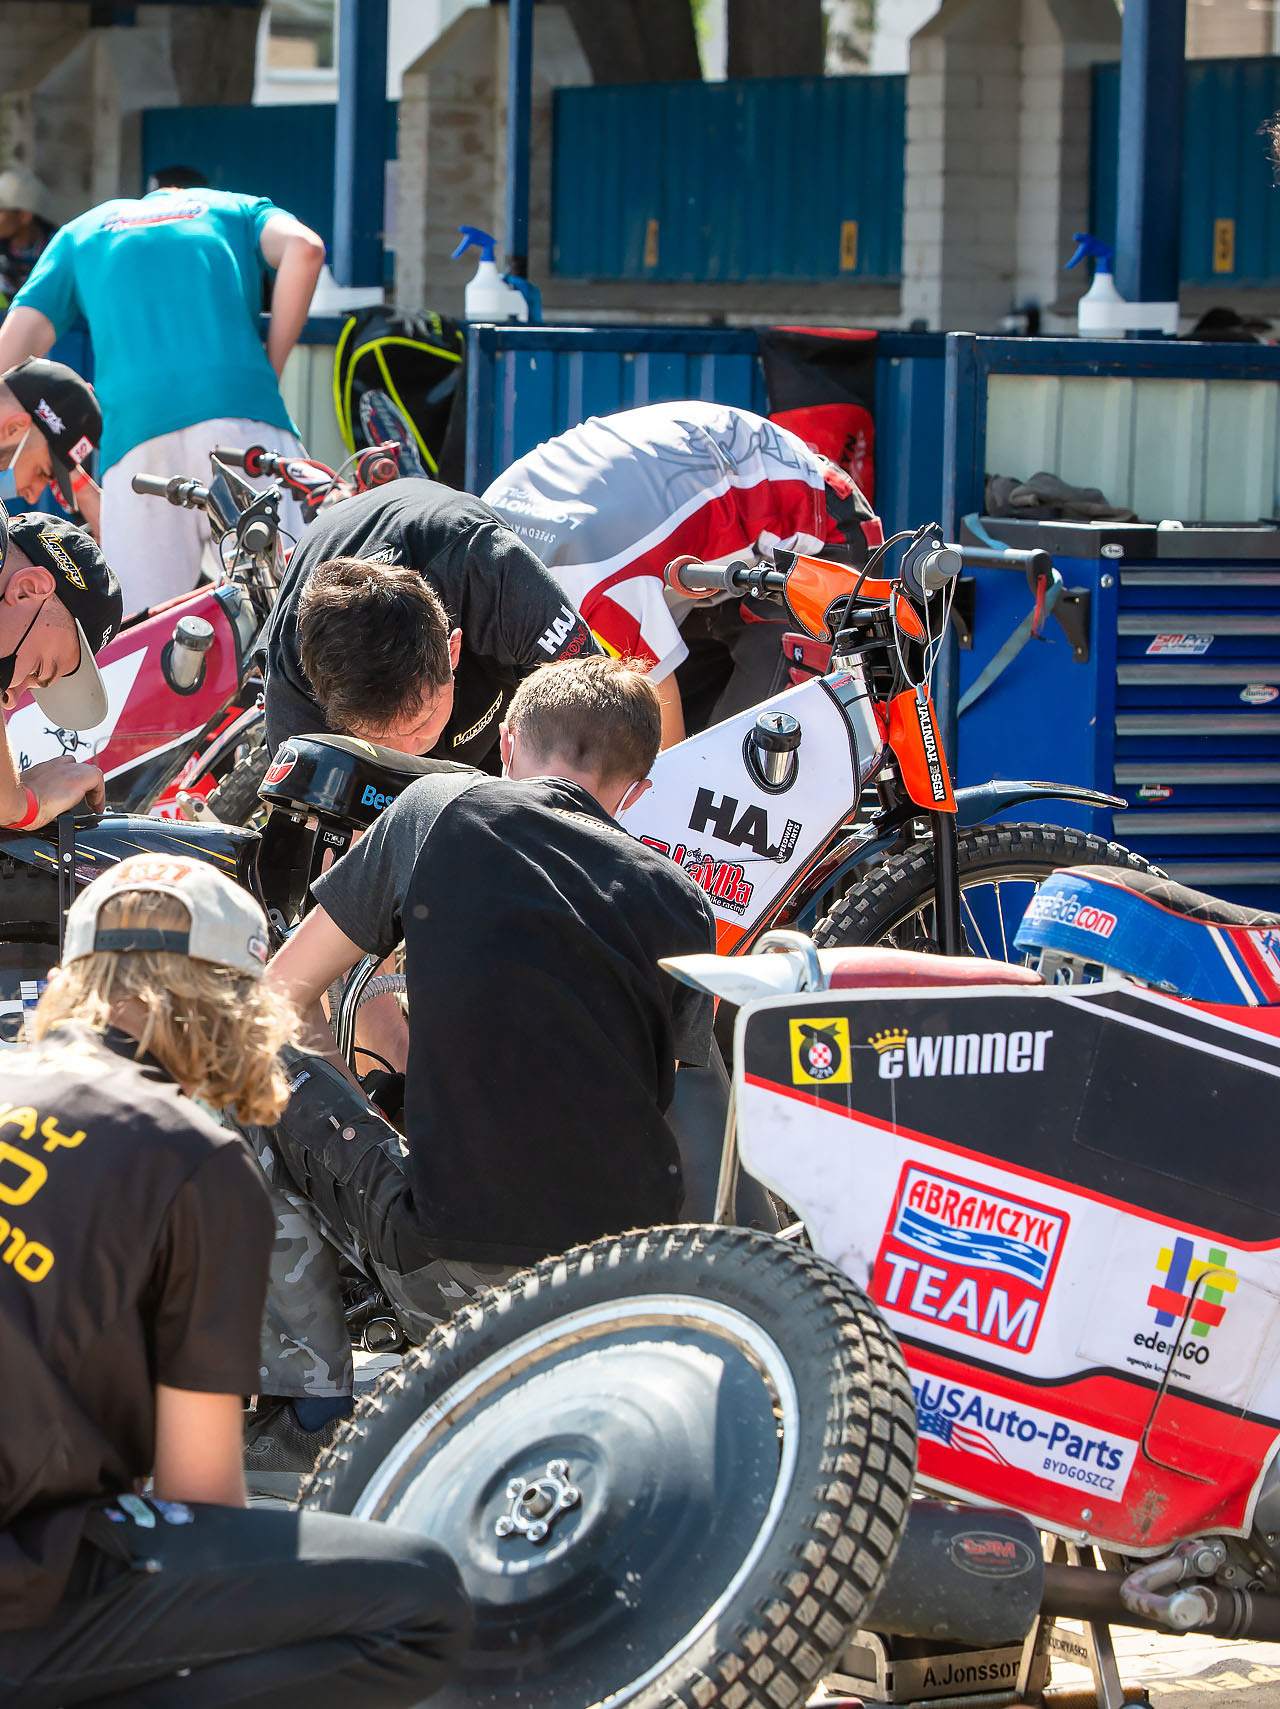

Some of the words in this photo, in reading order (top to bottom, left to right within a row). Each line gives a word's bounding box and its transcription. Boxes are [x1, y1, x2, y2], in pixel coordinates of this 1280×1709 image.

[536, 604, 577, 656] HAJ
[787, 822, 801, 850] PARTS
[808, 1067, 835, 1079] PZM
[908, 1179, 1055, 1252] ABRAMCZYK
[883, 1250, 1041, 1349] TEAM
[1042, 1457, 1116, 1492] BYDGOSZCZ
